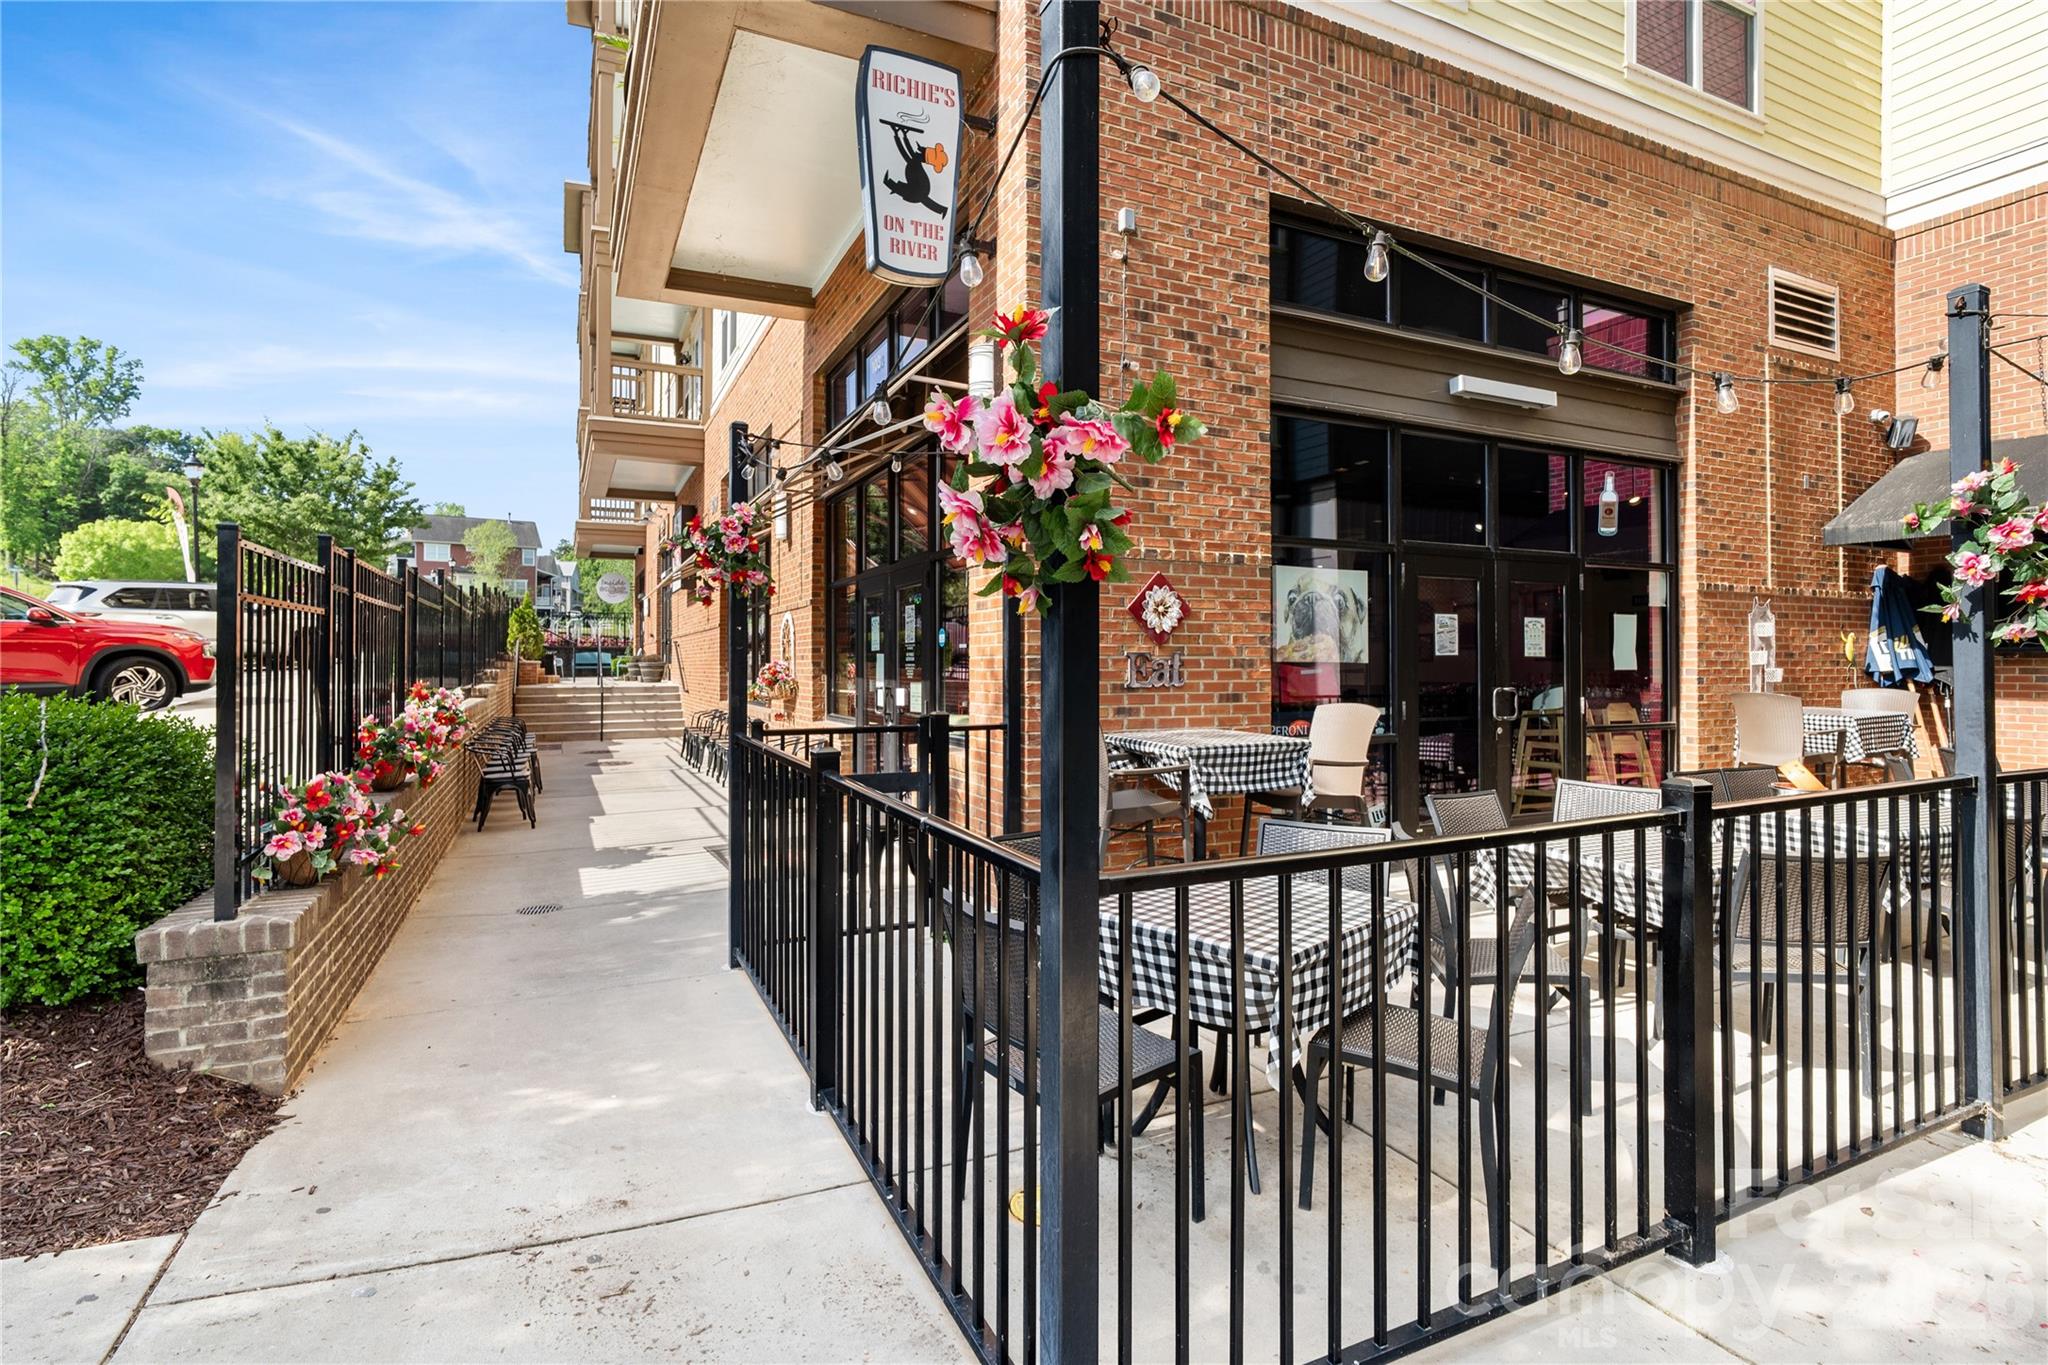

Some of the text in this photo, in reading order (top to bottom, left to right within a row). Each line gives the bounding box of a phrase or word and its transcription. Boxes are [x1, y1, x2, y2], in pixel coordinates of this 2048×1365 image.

[871, 68, 956, 108] RICHIE'S
[883, 214, 944, 241] ON THE
[889, 237, 938, 262] RIVER
[1124, 651, 1186, 689] Eat
